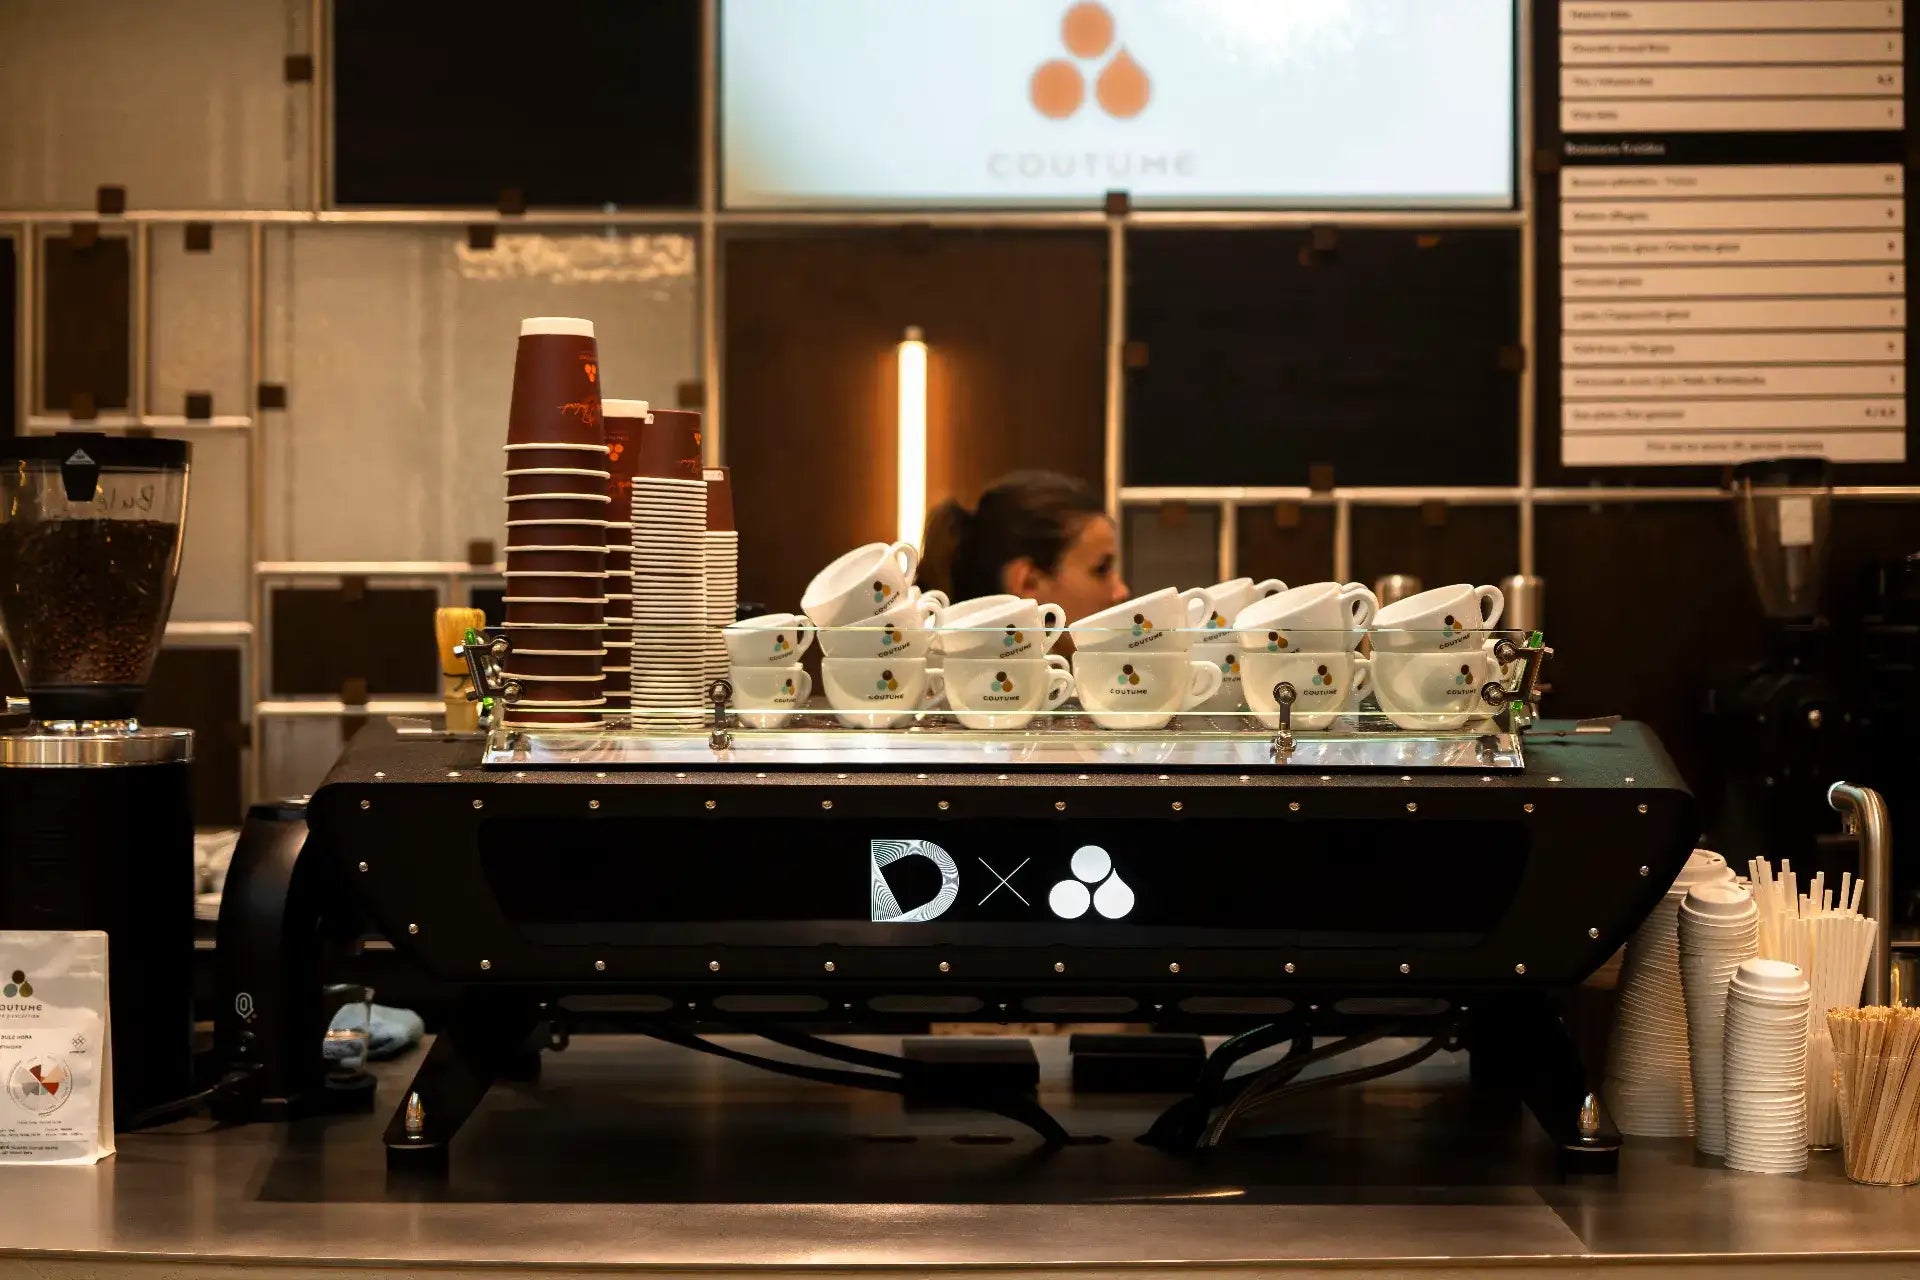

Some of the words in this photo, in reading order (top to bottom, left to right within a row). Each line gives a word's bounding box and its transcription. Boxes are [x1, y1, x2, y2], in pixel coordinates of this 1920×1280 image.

[986, 152, 1198, 178] COUTUME
[874, 591, 900, 616] COUTUME
[1128, 631, 1163, 649] COUTUME
[1439, 632, 1471, 650] COUTUME
[878, 642, 911, 659] COUTUME
[999, 642, 1032, 660] COUTUME
[868, 693, 904, 701] COUTUME
[1109, 688, 1148, 696] COUTUME
